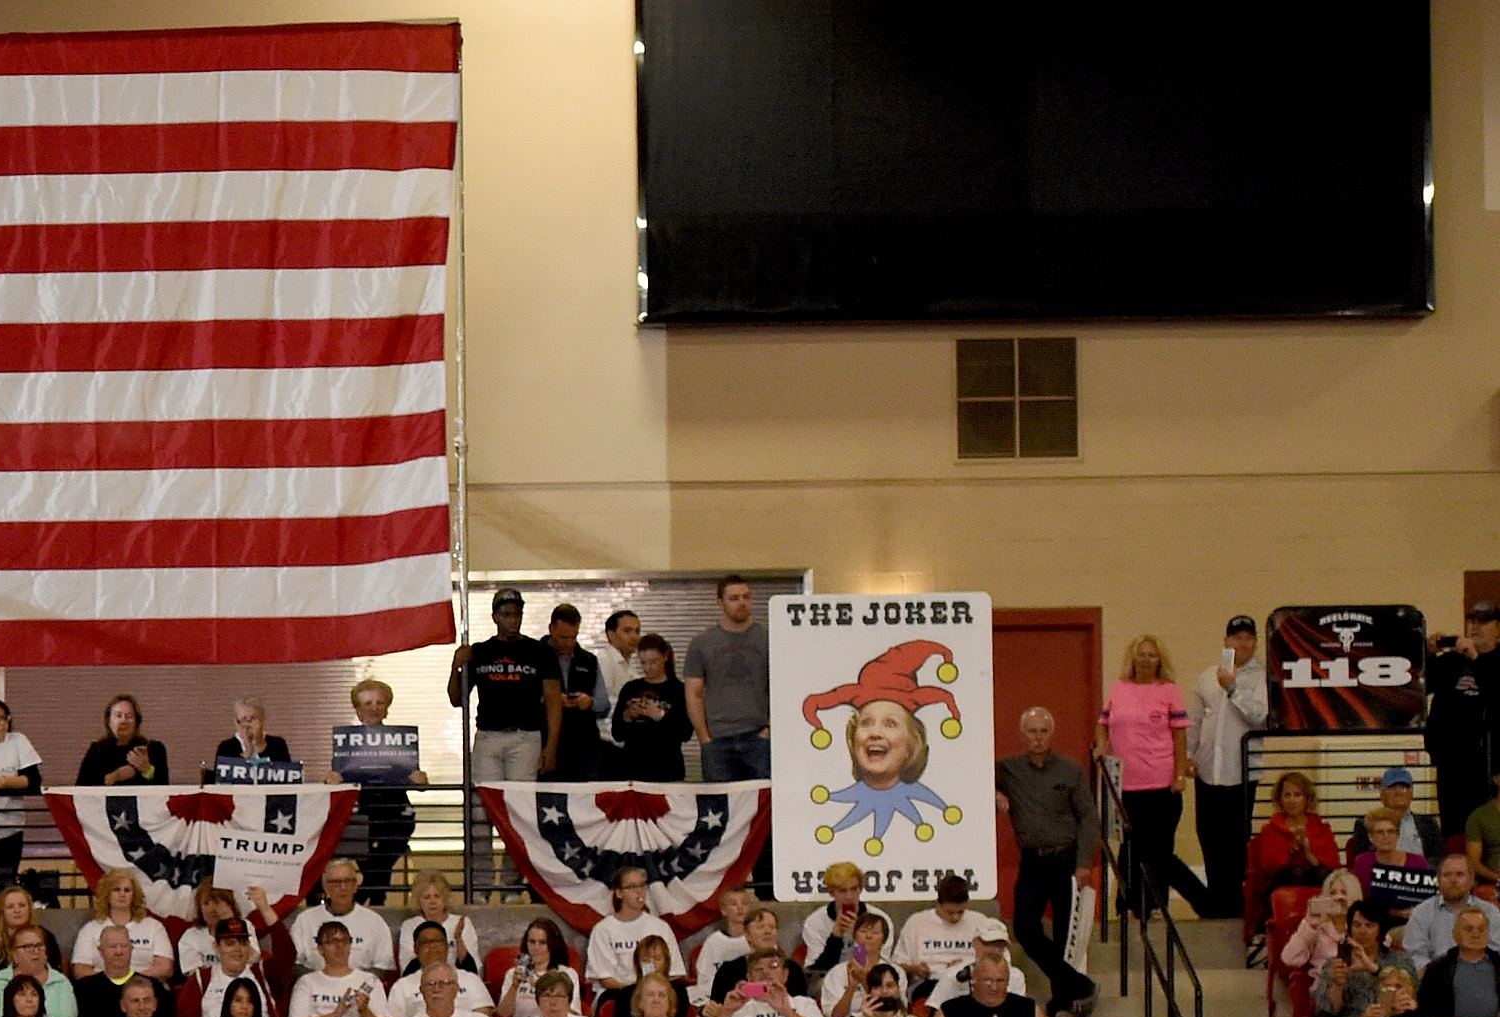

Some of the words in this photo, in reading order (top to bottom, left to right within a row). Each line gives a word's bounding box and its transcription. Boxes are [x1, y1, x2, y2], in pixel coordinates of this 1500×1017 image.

[787, 603, 853, 626] THE
[863, 601, 973, 626] JOKER
[507, 664, 536, 675] BACK
[1283, 656, 1412, 688] 118
[334, 732, 418, 747] TRUMP
[217, 764, 302, 782] TRUMP
[220, 837, 304, 855] TRUMP
[792, 870, 902, 893] JOER
[1373, 868, 1438, 886] TRUM
